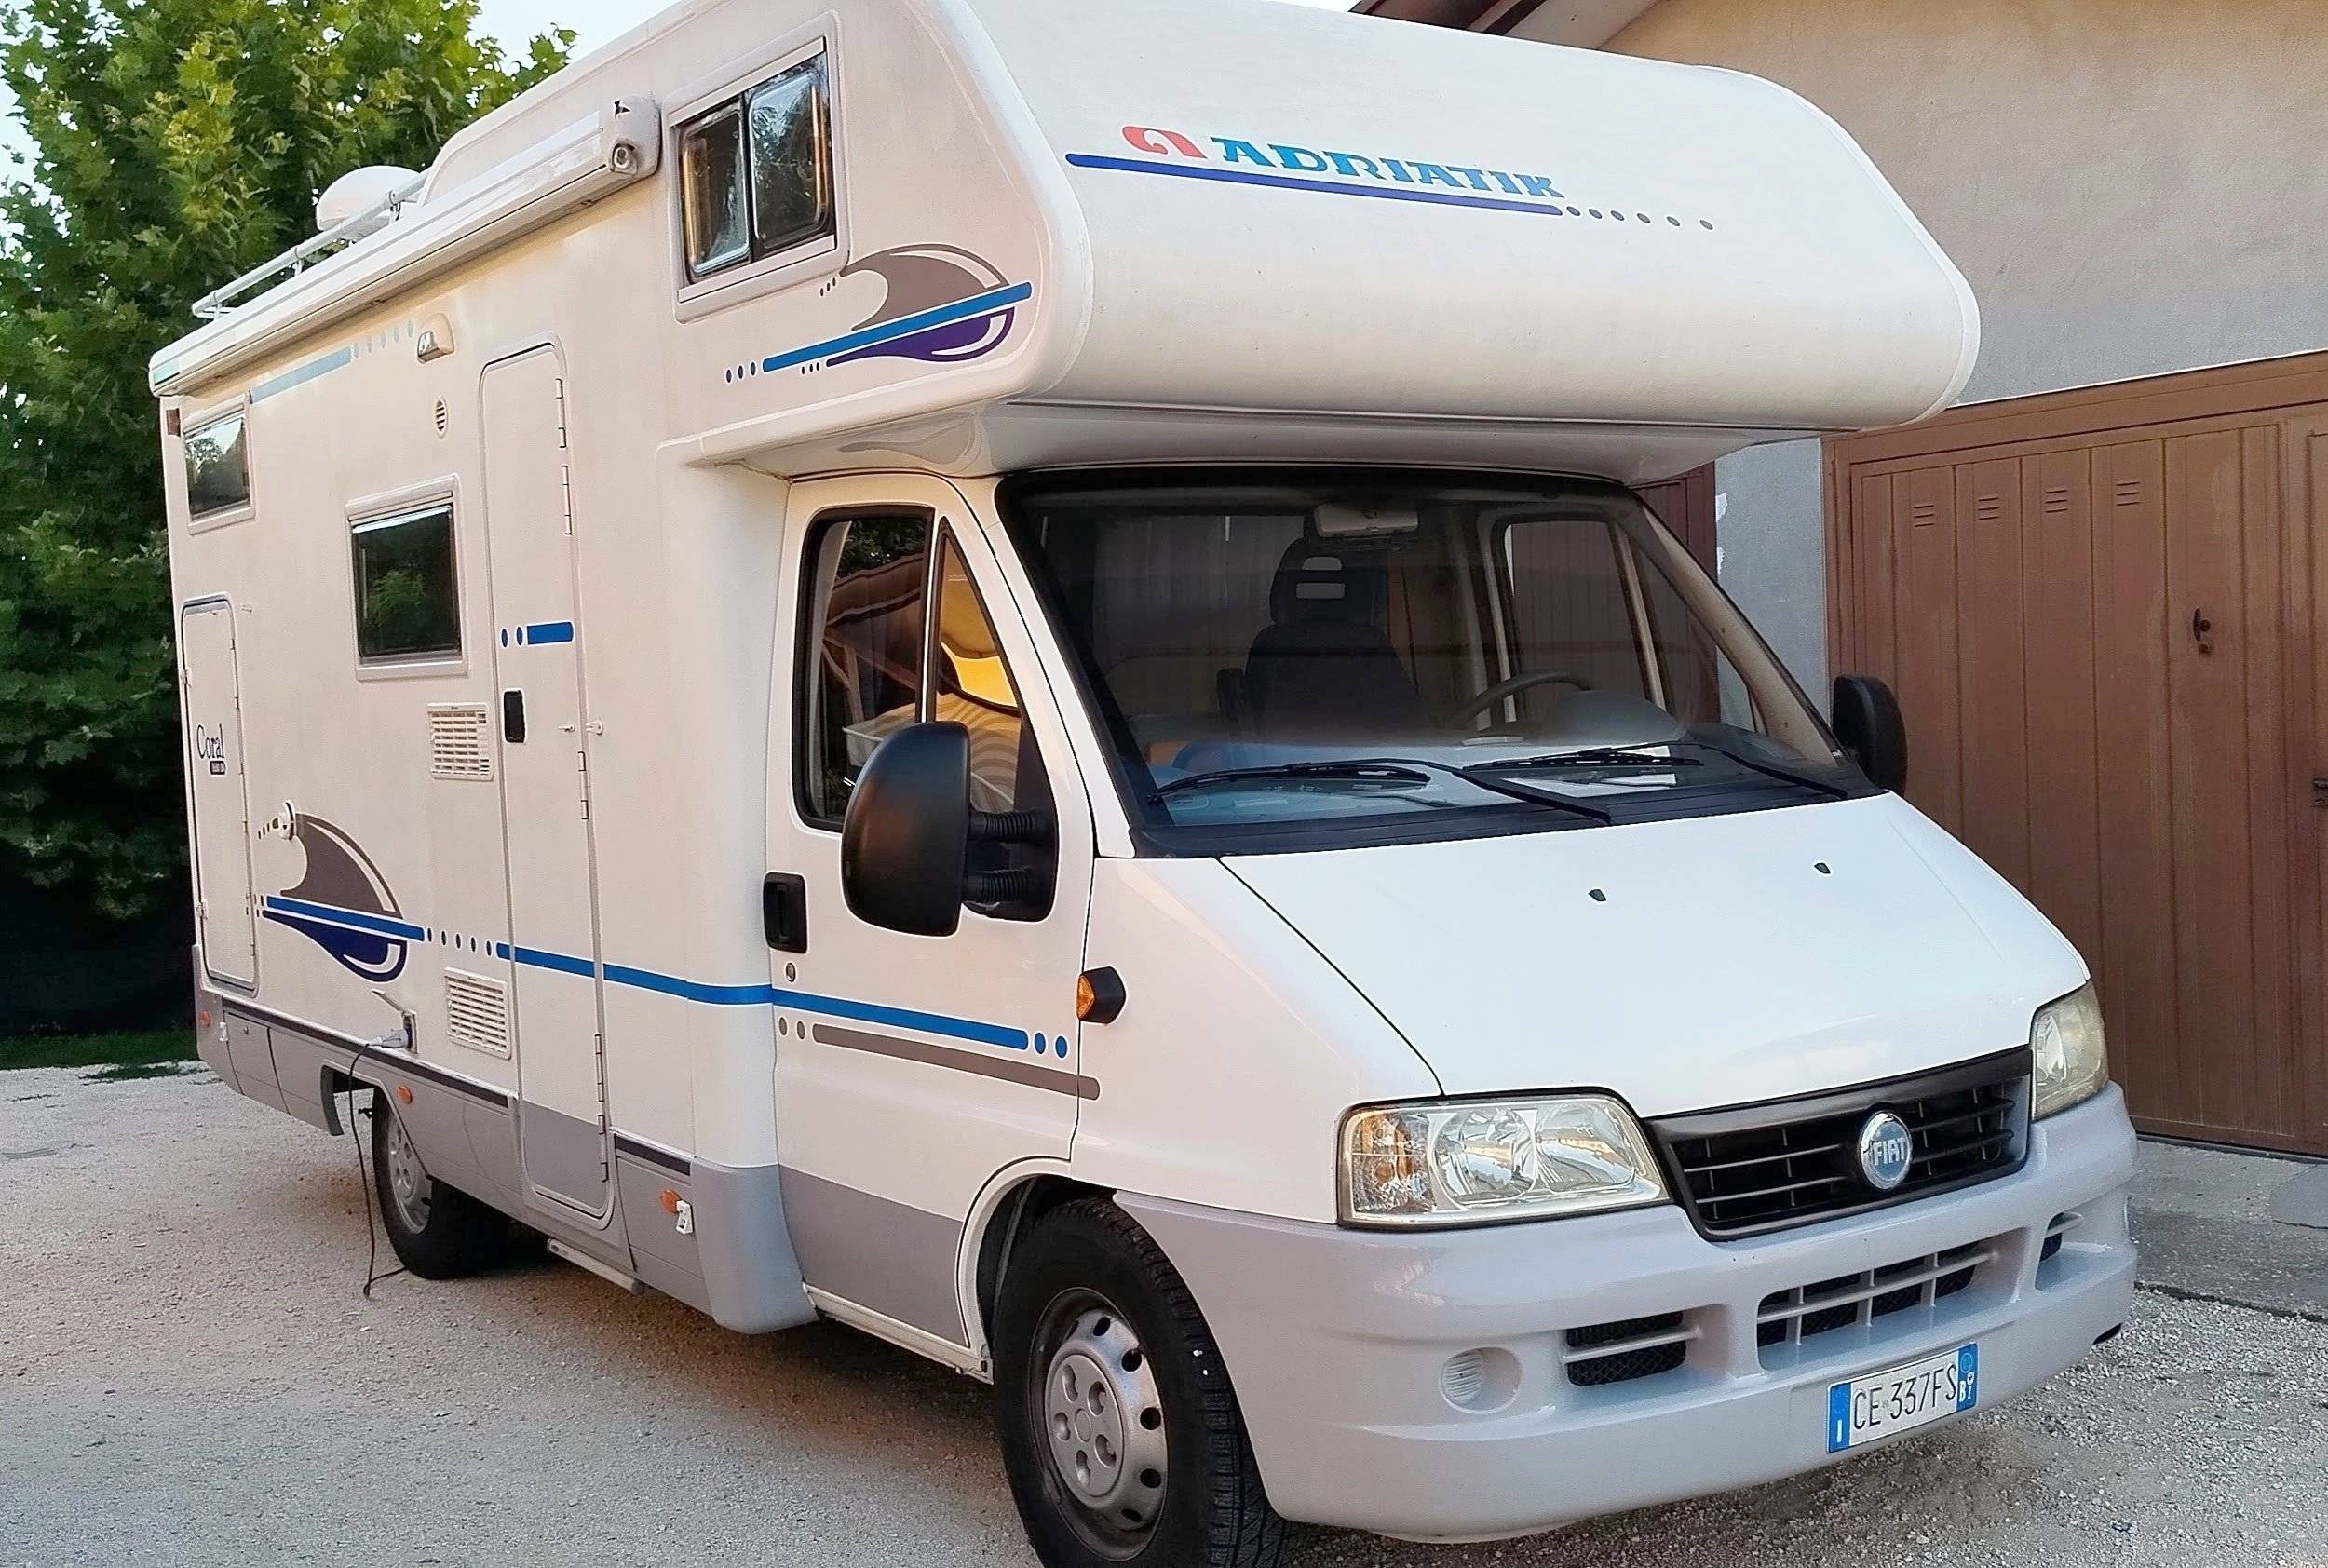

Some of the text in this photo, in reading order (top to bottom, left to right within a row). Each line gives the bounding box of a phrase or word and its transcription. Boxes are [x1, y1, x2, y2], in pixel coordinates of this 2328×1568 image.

[1211, 136, 1564, 198] ADRIATIK
[196, 723, 224, 759] Coral
[1873, 1137, 1906, 1166] FIAT
[1853, 1386, 1883, 1430] CE
[1889, 1363, 1957, 1420] 337FS
